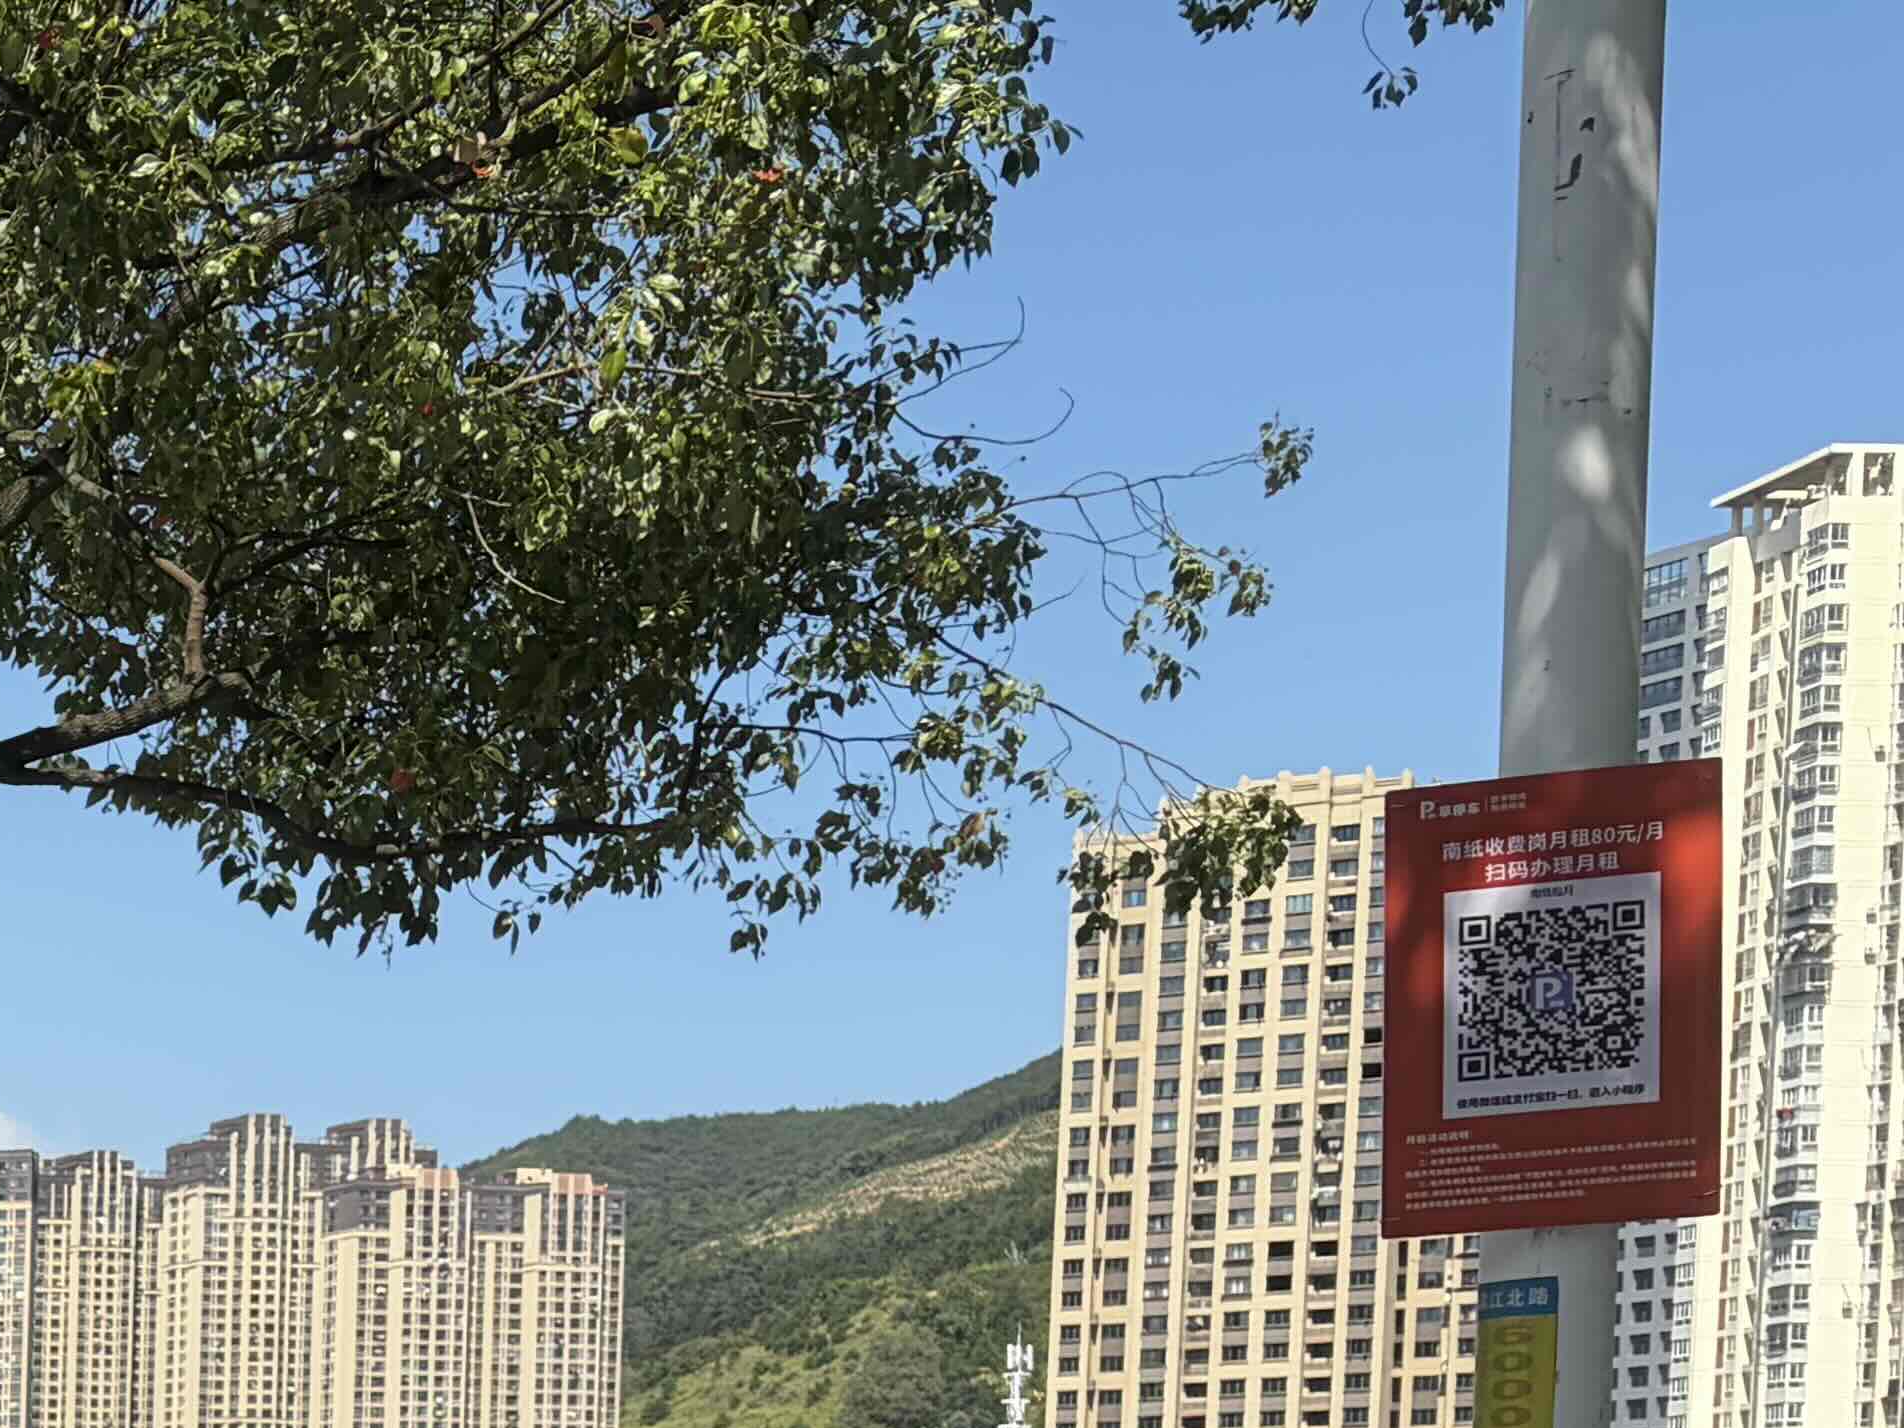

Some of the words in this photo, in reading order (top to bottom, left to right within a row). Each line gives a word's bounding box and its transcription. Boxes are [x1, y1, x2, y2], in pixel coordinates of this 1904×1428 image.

[1485, 851, 1619, 884] 扫码办理月租
